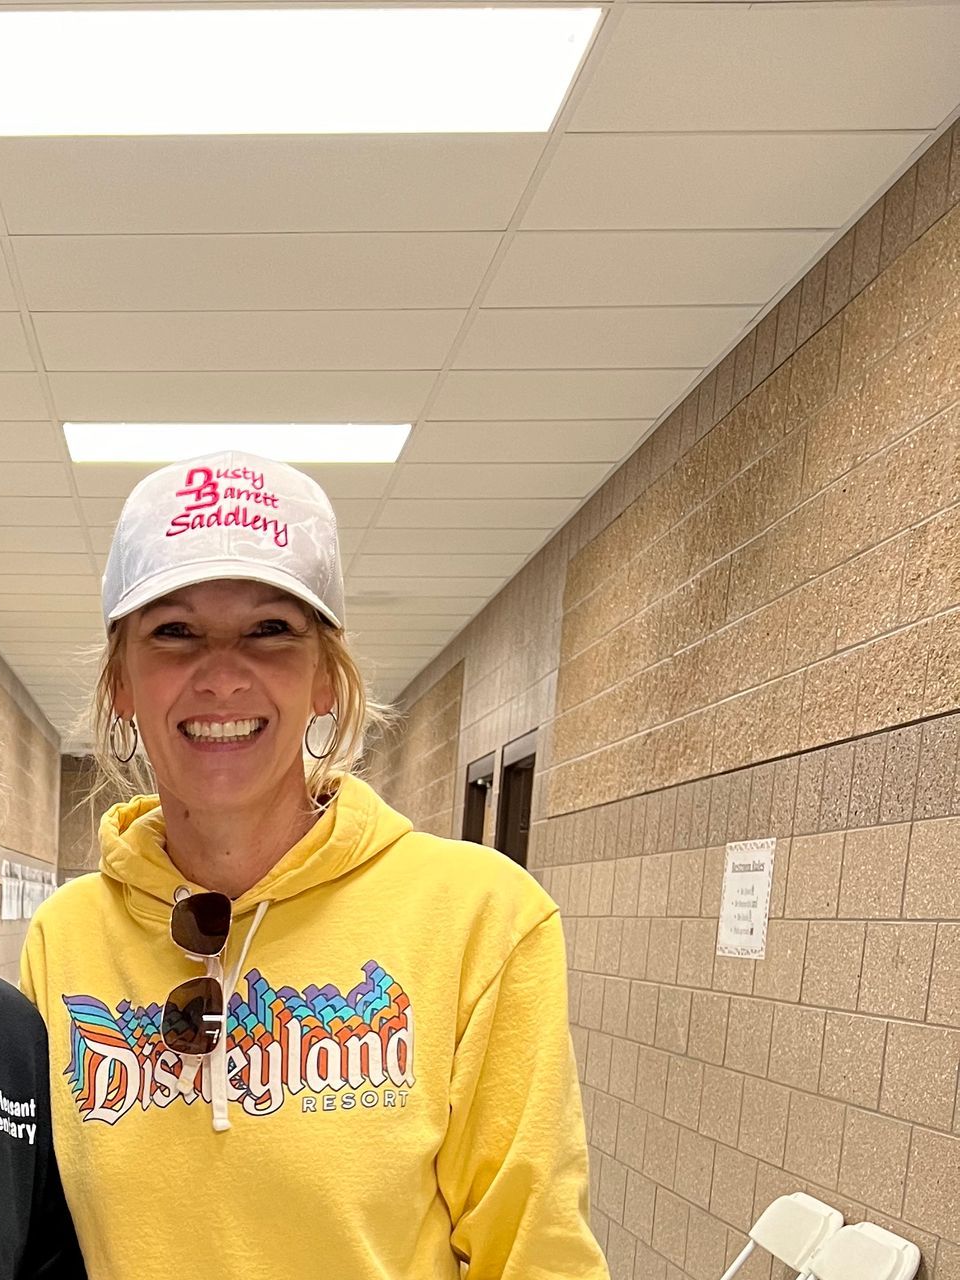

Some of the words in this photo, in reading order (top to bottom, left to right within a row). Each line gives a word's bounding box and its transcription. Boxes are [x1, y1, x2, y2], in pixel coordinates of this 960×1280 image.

[176, 466, 264, 497] Dusty
[184, 481, 279, 511] Barrett
[166, 505, 289, 548] Saddlery
[301, 1089, 411, 1113] RESORT
